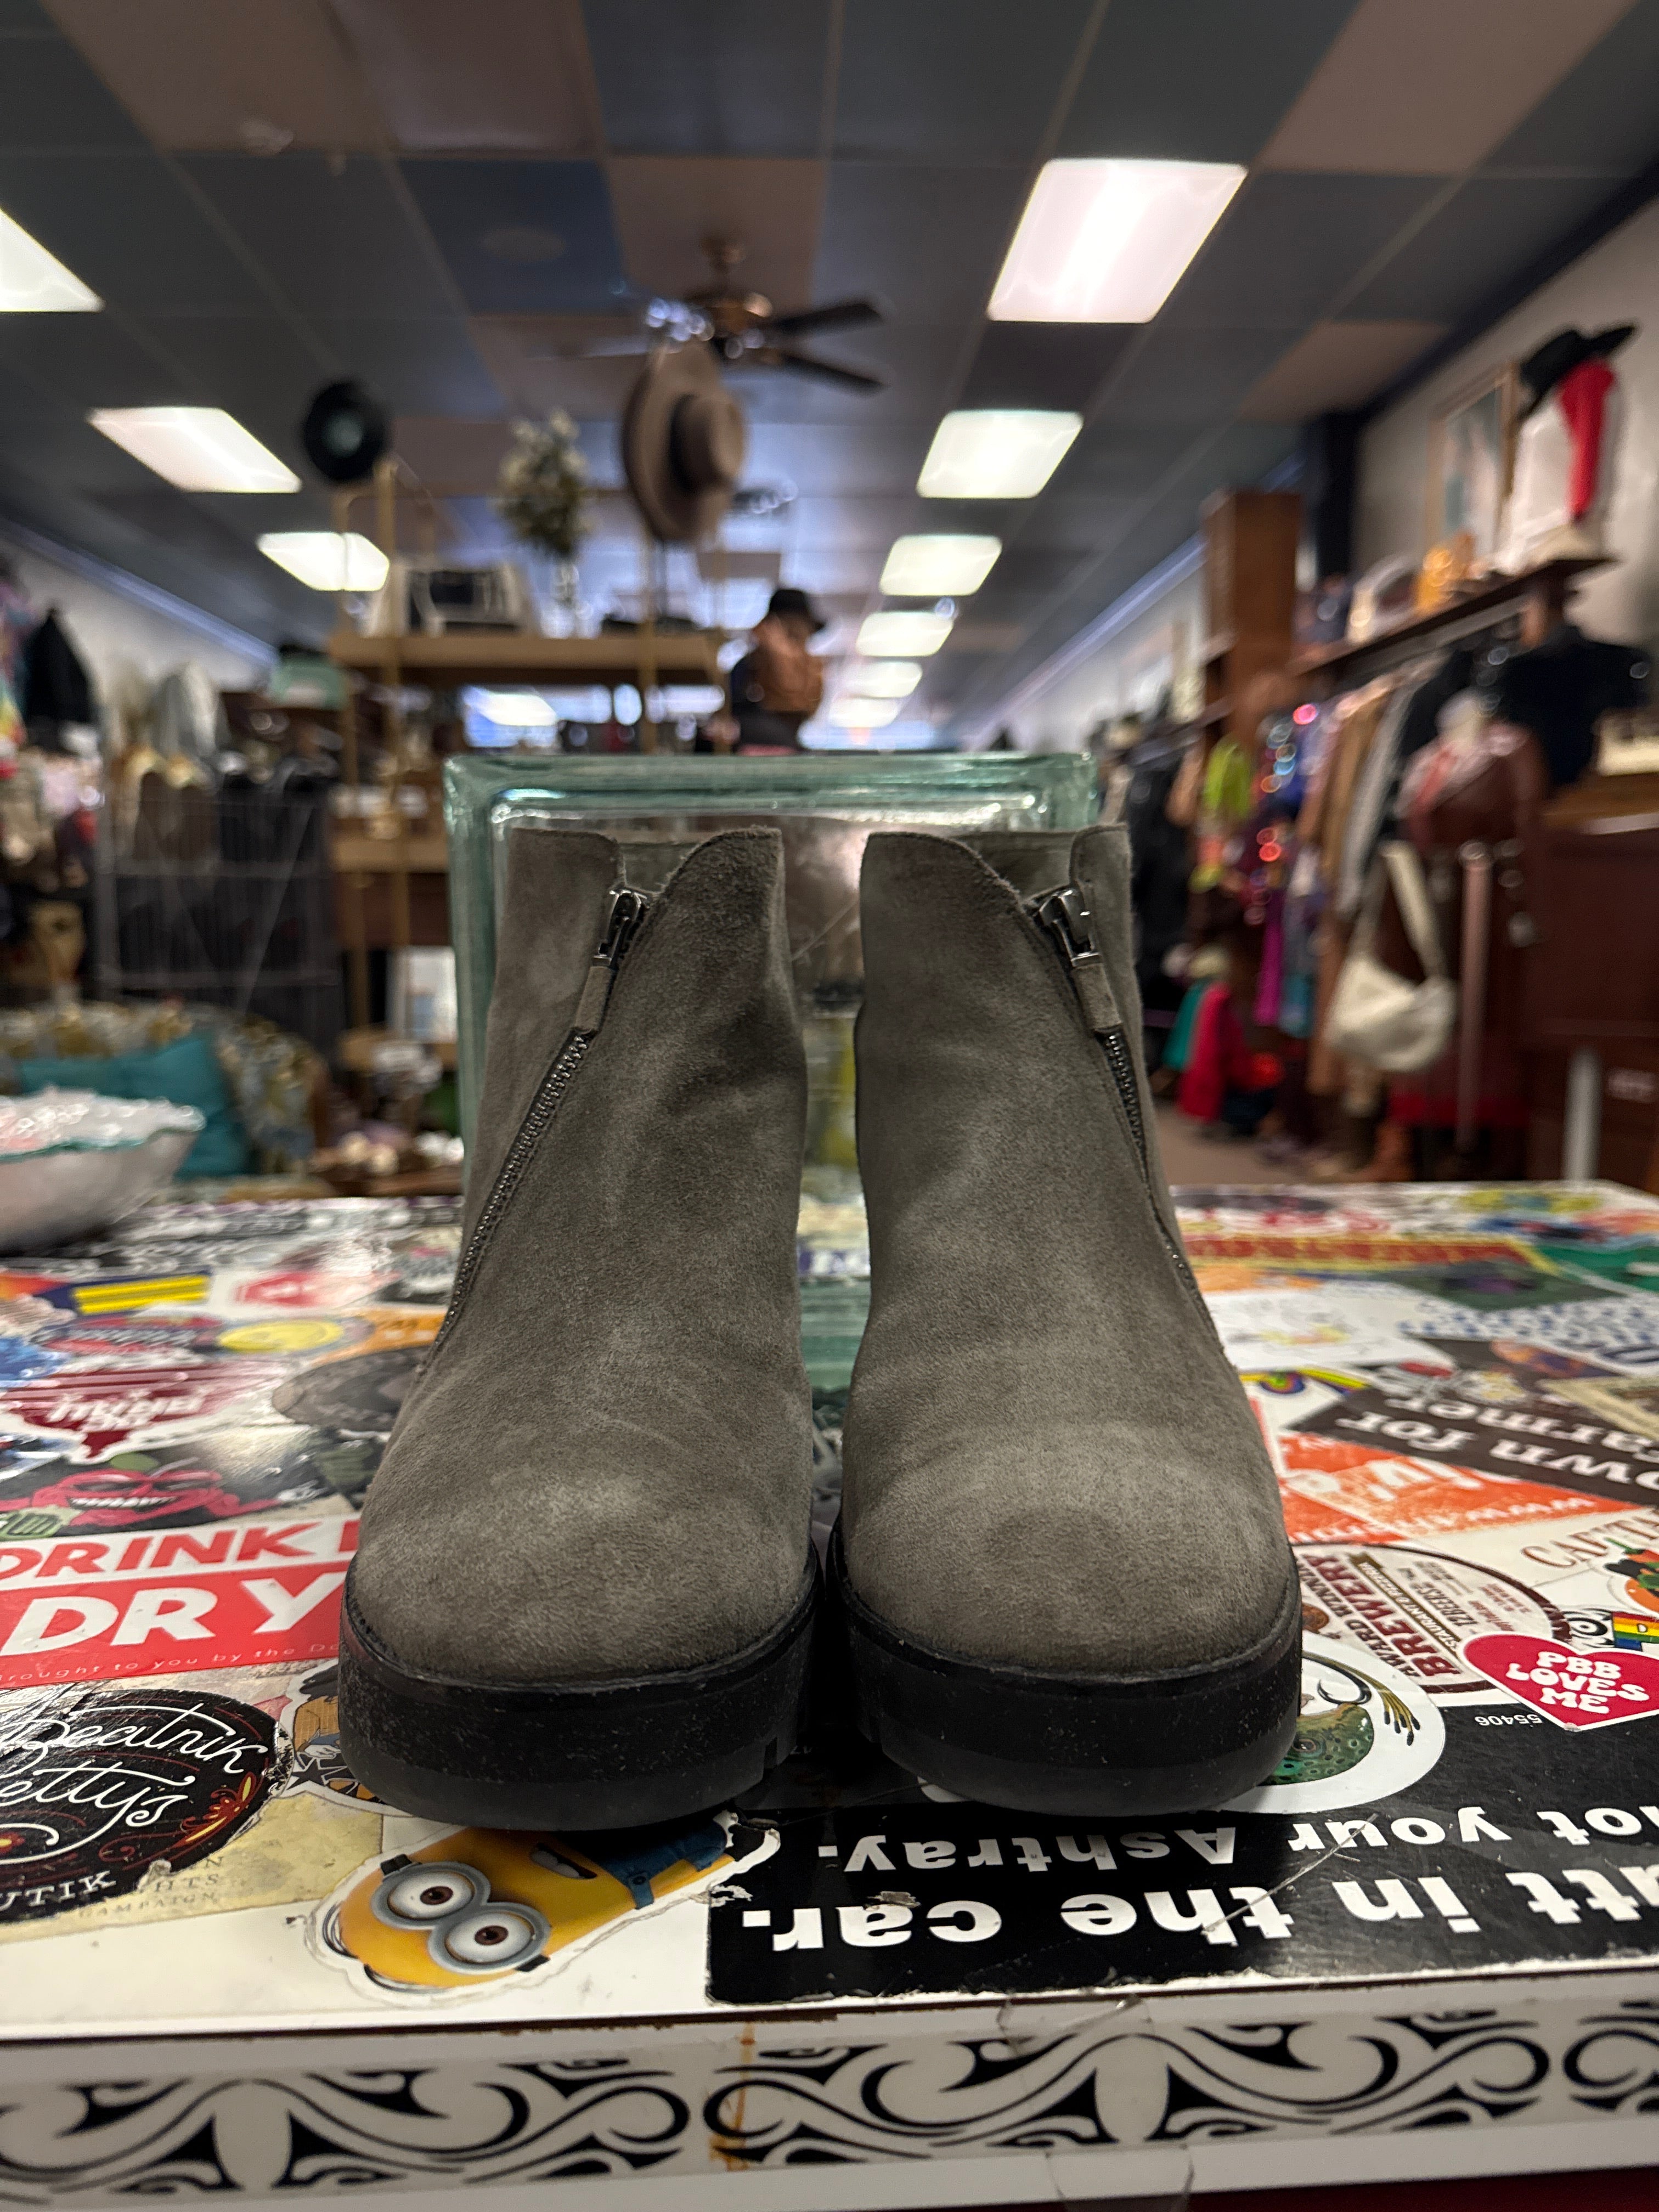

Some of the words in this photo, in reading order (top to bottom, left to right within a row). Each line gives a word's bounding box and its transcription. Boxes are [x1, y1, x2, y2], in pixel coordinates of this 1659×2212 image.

[1335, 1412, 1480, 1451] for
[0, 1571, 349, 1656] DRY
[1302, 1554, 1462, 1677] BREWERY
[0, 1666, 100, 1681] rought
[153, 1657, 198, 1669] you
[213, 1654, 241, 1663] by
[254, 1647, 295, 1658] the
[1345, 1620, 1420, 1677] AWARD
[1537, 1651, 1621, 1679] PBB
[1506, 1663, 1649, 1701] LOVES
[1540, 1687, 1610, 1714] ME
[1475, 1714, 1543, 1726] 55406
[819, 1827, 1236, 1872] Ashtray.
[1288, 1807, 1513, 1851] your
[742, 1900, 1002, 1951] car.
[1060, 1887, 1294, 1946] the
[1332, 1876, 1481, 1933] in
